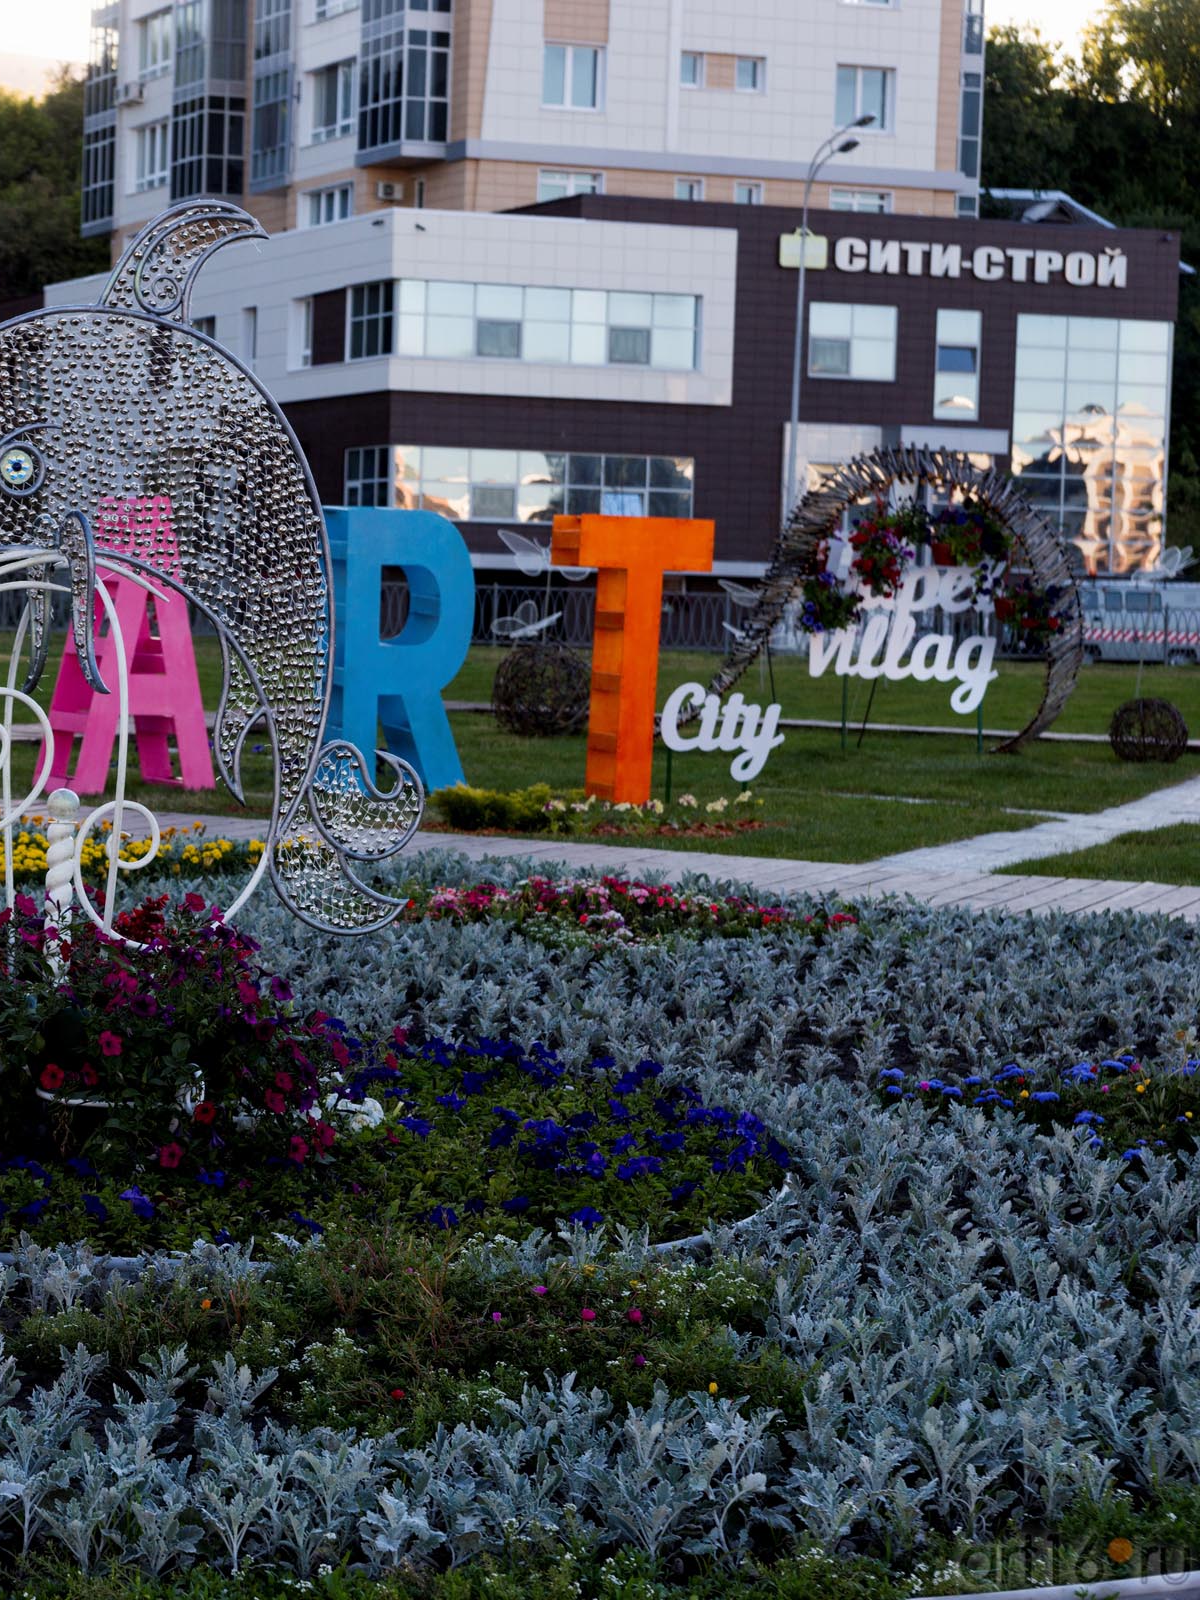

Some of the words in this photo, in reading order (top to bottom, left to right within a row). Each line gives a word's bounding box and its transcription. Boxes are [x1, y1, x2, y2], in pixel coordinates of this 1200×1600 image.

[835, 237, 1128, 289] СИТИ-СТРОЙ
[33, 496, 715, 805] ART
[661, 682, 785, 782] City
